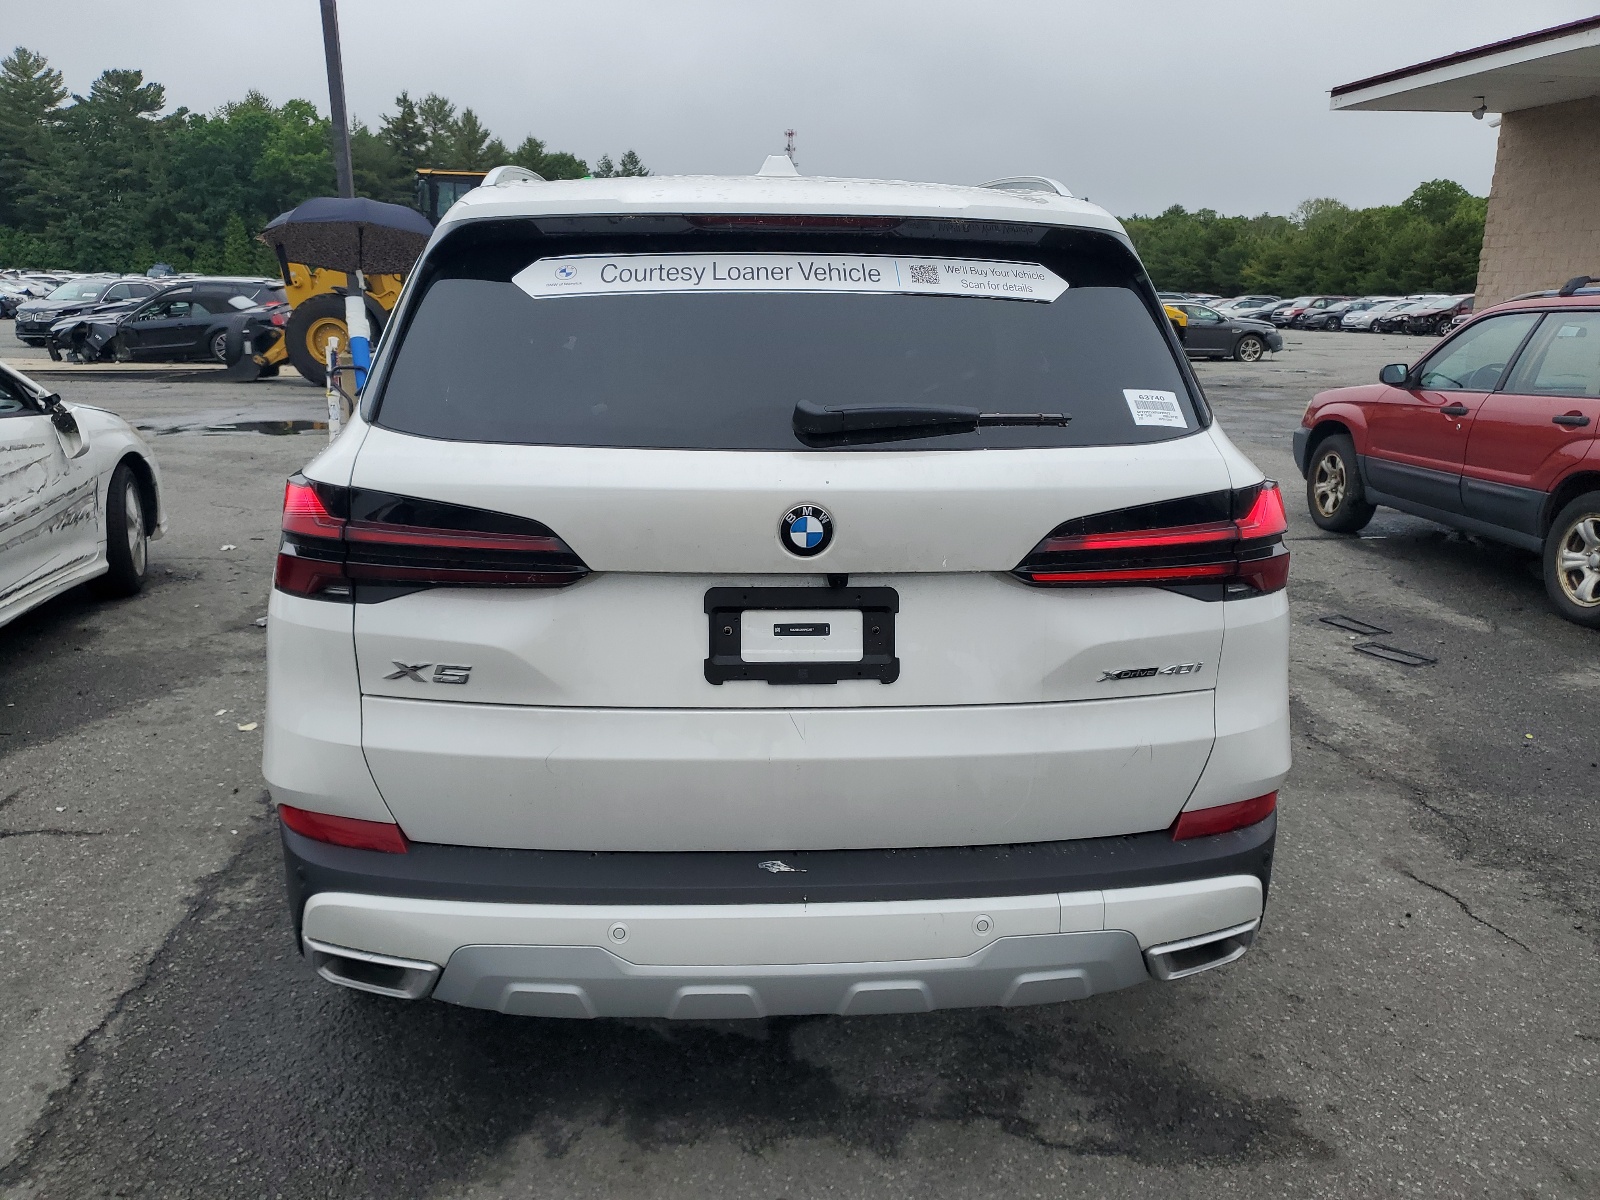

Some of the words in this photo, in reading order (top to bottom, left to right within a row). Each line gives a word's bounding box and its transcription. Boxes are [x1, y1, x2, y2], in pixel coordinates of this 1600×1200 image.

[600, 263, 706, 285] Courtesy
[712, 262, 793, 281] Loaner
[798, 261, 881, 283] Vehicle
[943, 264, 968, 275] We'll
[969, 266, 988, 278] Buy
[989, 267, 1010, 277] Your
[1010, 269, 1045, 281] Vehicle
[960, 278, 986, 290] Scan
[987, 280, 1000, 291] for
[1002, 282, 1033, 293] details
[1138, 394, 1165, 402] 63740
[785, 506, 830, 524] BMW
[382, 660, 473, 685] X5
